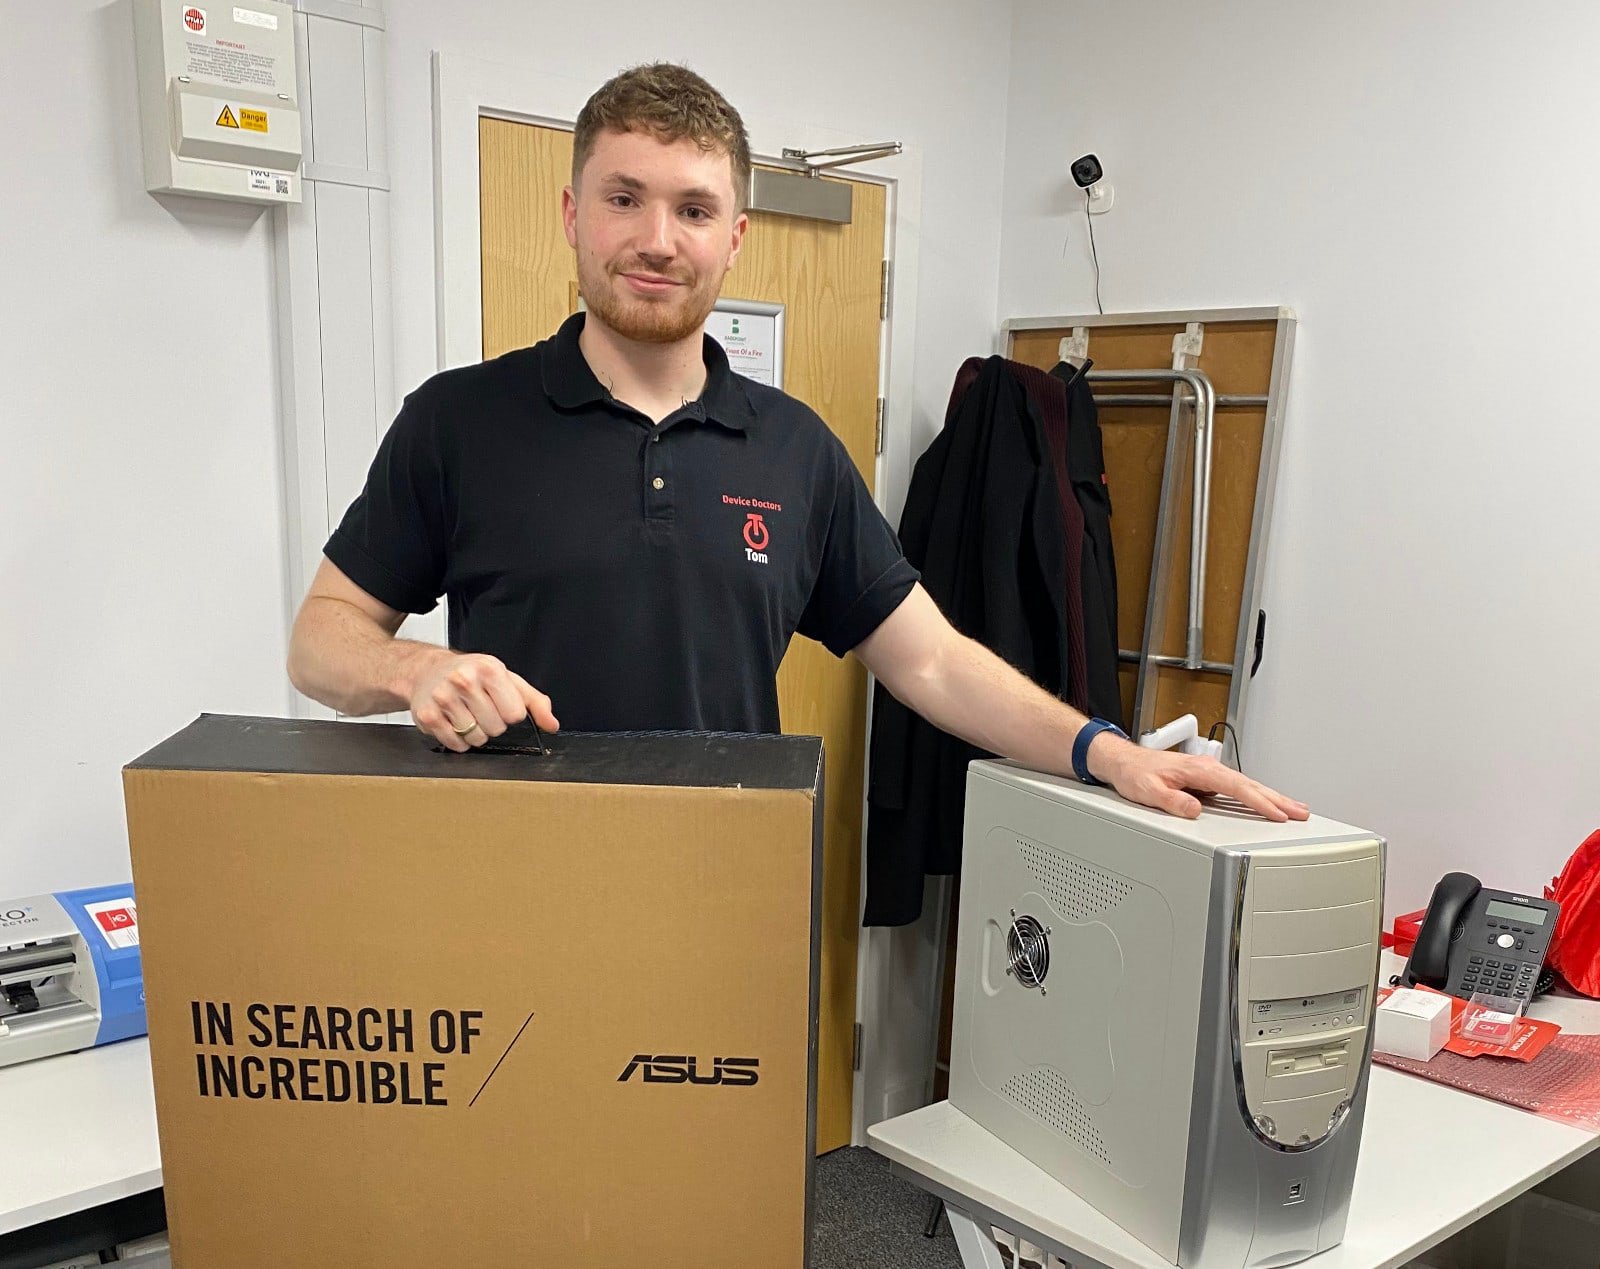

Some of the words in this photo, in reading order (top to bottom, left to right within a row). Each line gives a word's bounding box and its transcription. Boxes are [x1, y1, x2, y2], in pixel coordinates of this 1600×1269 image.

[241, 112, 266, 122] Danger
[752, 349, 763, 357] Fire
[722, 494, 751, 506] Device
[752, 498, 782, 512] Doctors
[745, 548, 768, 564] Tom
[0, 917, 39, 927] ECTOR
[191, 1001, 234, 1046] IN
[247, 1004, 415, 1054] SEARCH
[430, 1009, 483, 1054] OF
[616, 1055, 759, 1086] ASUS
[195, 1054, 448, 1106] INCREDIBLE
